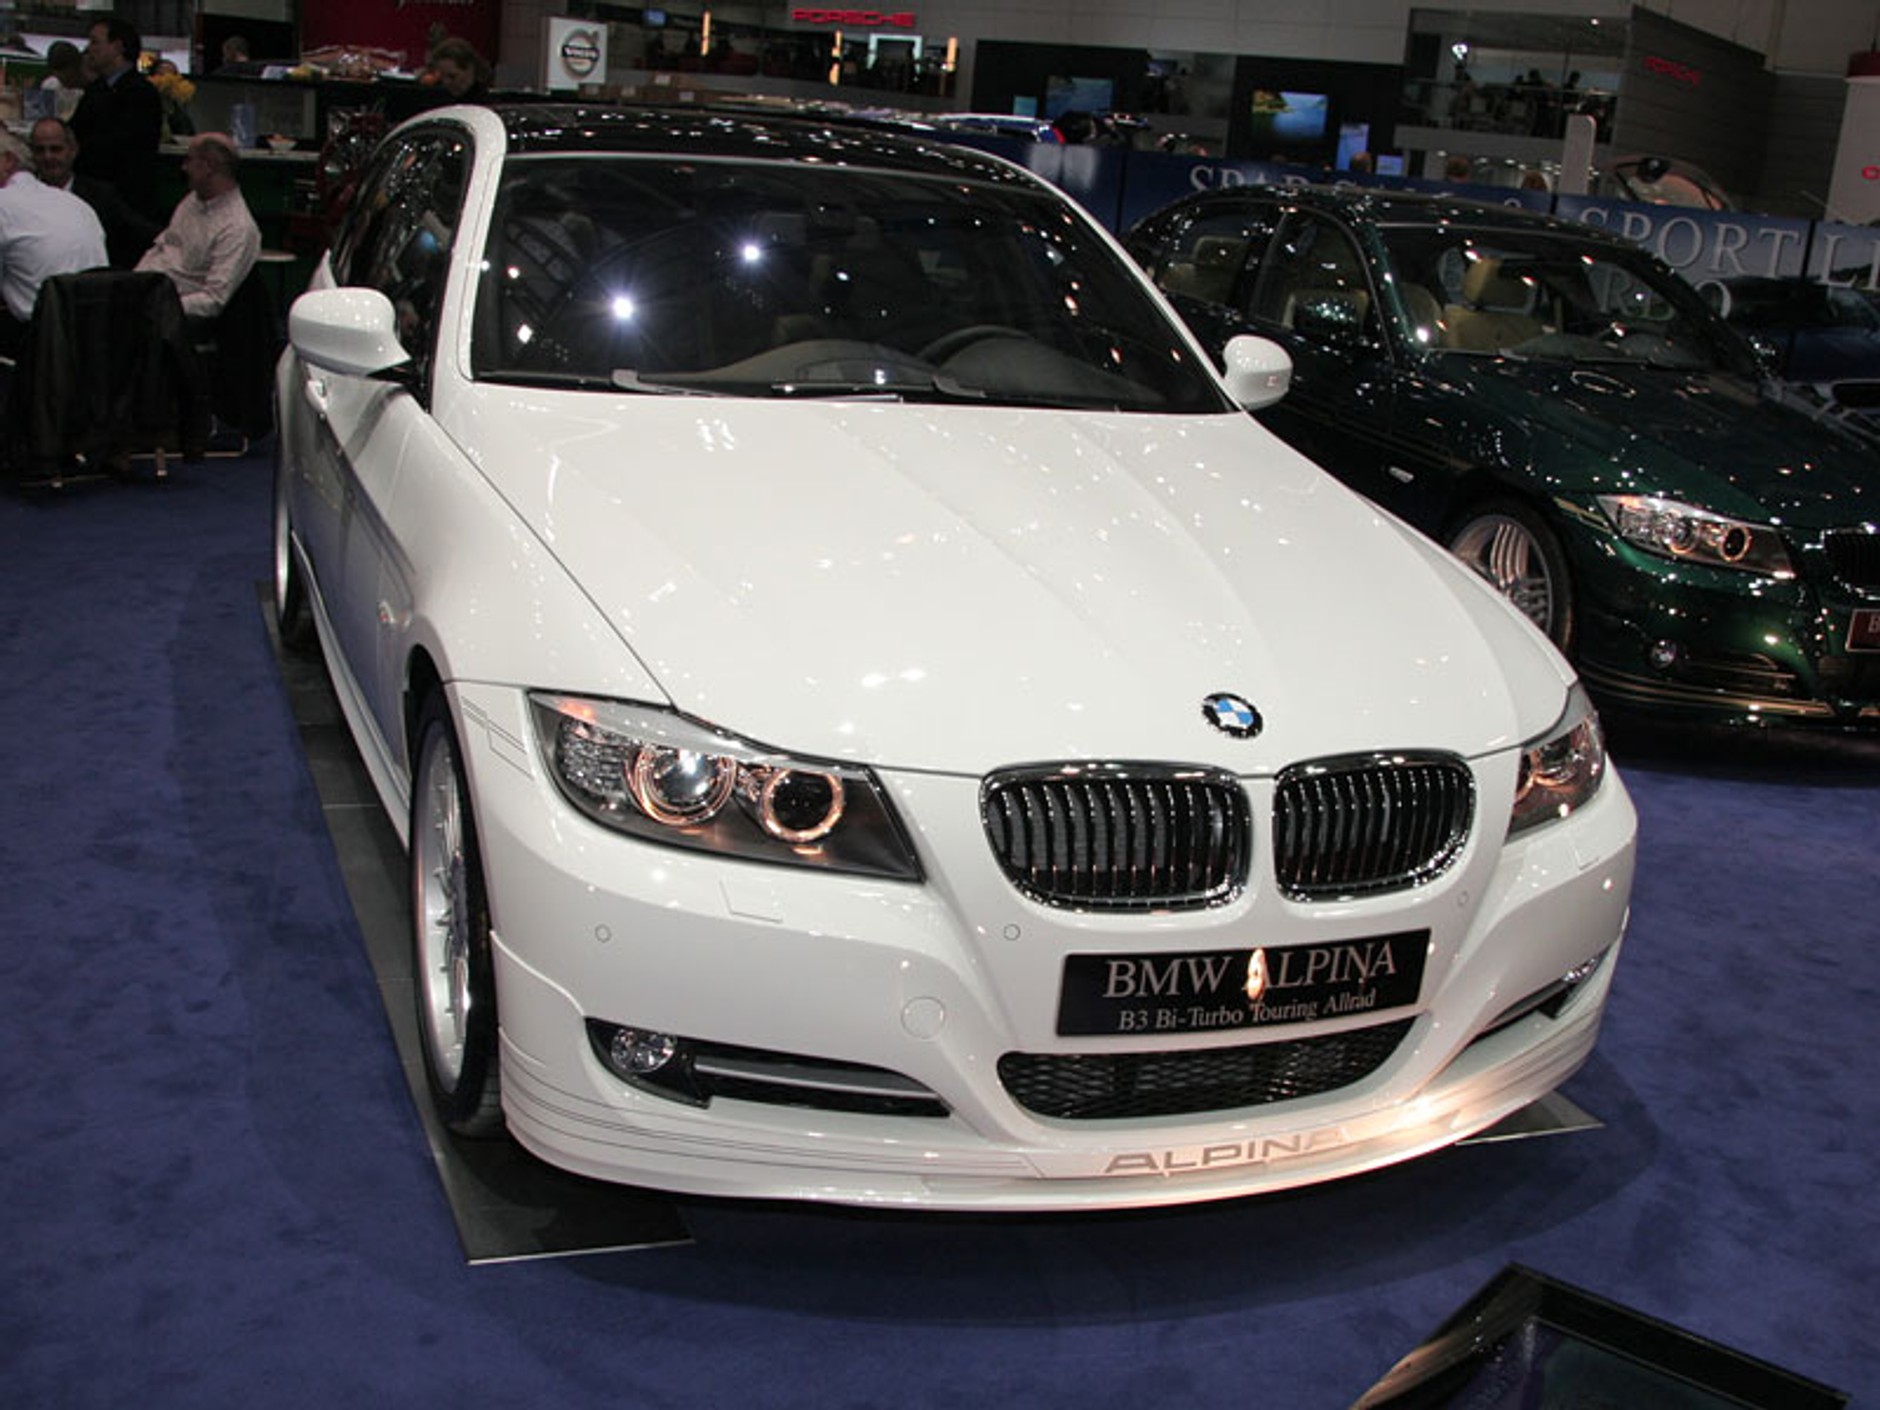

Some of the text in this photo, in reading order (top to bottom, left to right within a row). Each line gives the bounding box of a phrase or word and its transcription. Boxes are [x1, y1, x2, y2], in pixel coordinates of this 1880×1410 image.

[792, 9, 916, 27] PORSCHE
[1103, 942, 1397, 999] BMW ALPINA
[1119, 988, 1377, 1031] B3 Bi-Turbo Touring Allrad
[1104, 1127, 1352, 1174] ALPINA
